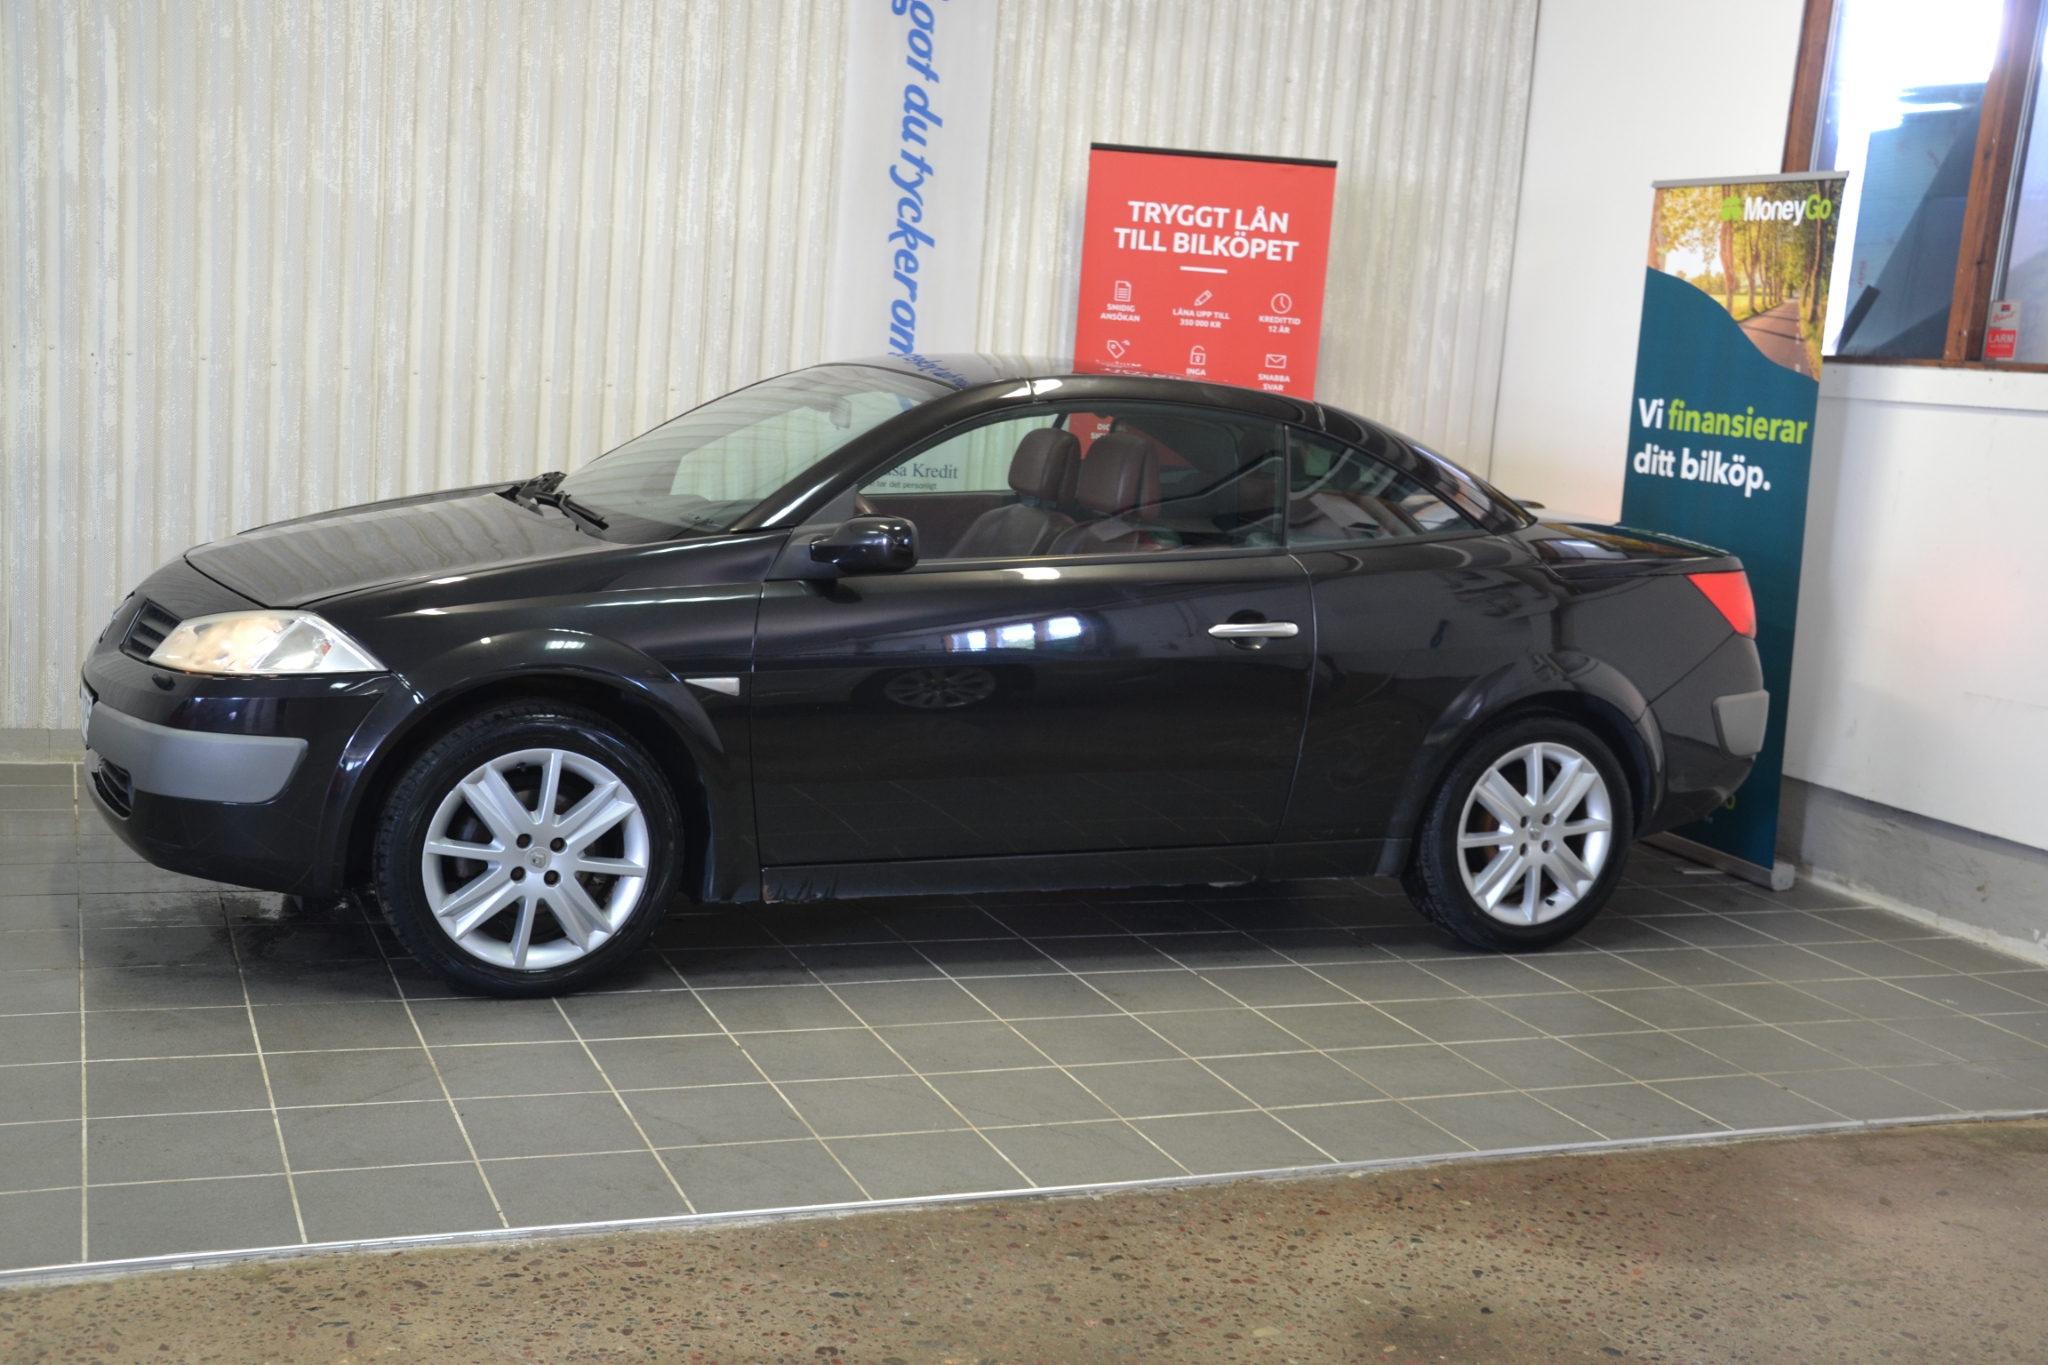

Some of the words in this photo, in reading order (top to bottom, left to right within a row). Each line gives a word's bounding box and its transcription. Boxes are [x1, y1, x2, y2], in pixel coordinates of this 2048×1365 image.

[901, 84, 943, 146] du
[1744, 194, 1832, 226] MoneyGo
[1128, 200, 1230, 228] TRYGGT
[1235, 205, 1289, 233] LÅN
[1114, 227, 1167, 252] TILL
[1173, 231, 1299, 262] BILKÖPET
[1107, 303, 1135, 312] SMIDIG
[1100, 312, 1141, 322] ANSÖKAN
[1172, 307, 1195, 317] LÅNA
[1196, 310, 1213, 318] UPP
[1214, 312, 1230, 320] TILL
[1259, 315, 1301, 325] KREDITTID
[1268, 325, 1277, 333] 12
[1278, 325, 1290, 334] ÅR
[1989, 334, 2015, 344] LARM
[1186, 368, 1206, 376] INGA
[1258, 373, 1290, 383] SNABBA
[1263, 383, 1284, 391] SVAR
[1638, 398, 1664, 429] Vi
[1668, 399, 1808, 444] finansierar
[912, 463, 958, 479] Kredit
[1634, 443, 1675, 477] ditt
[1680, 448, 1771, 498] bilköp.
[903, 482, 937, 490] personligt
